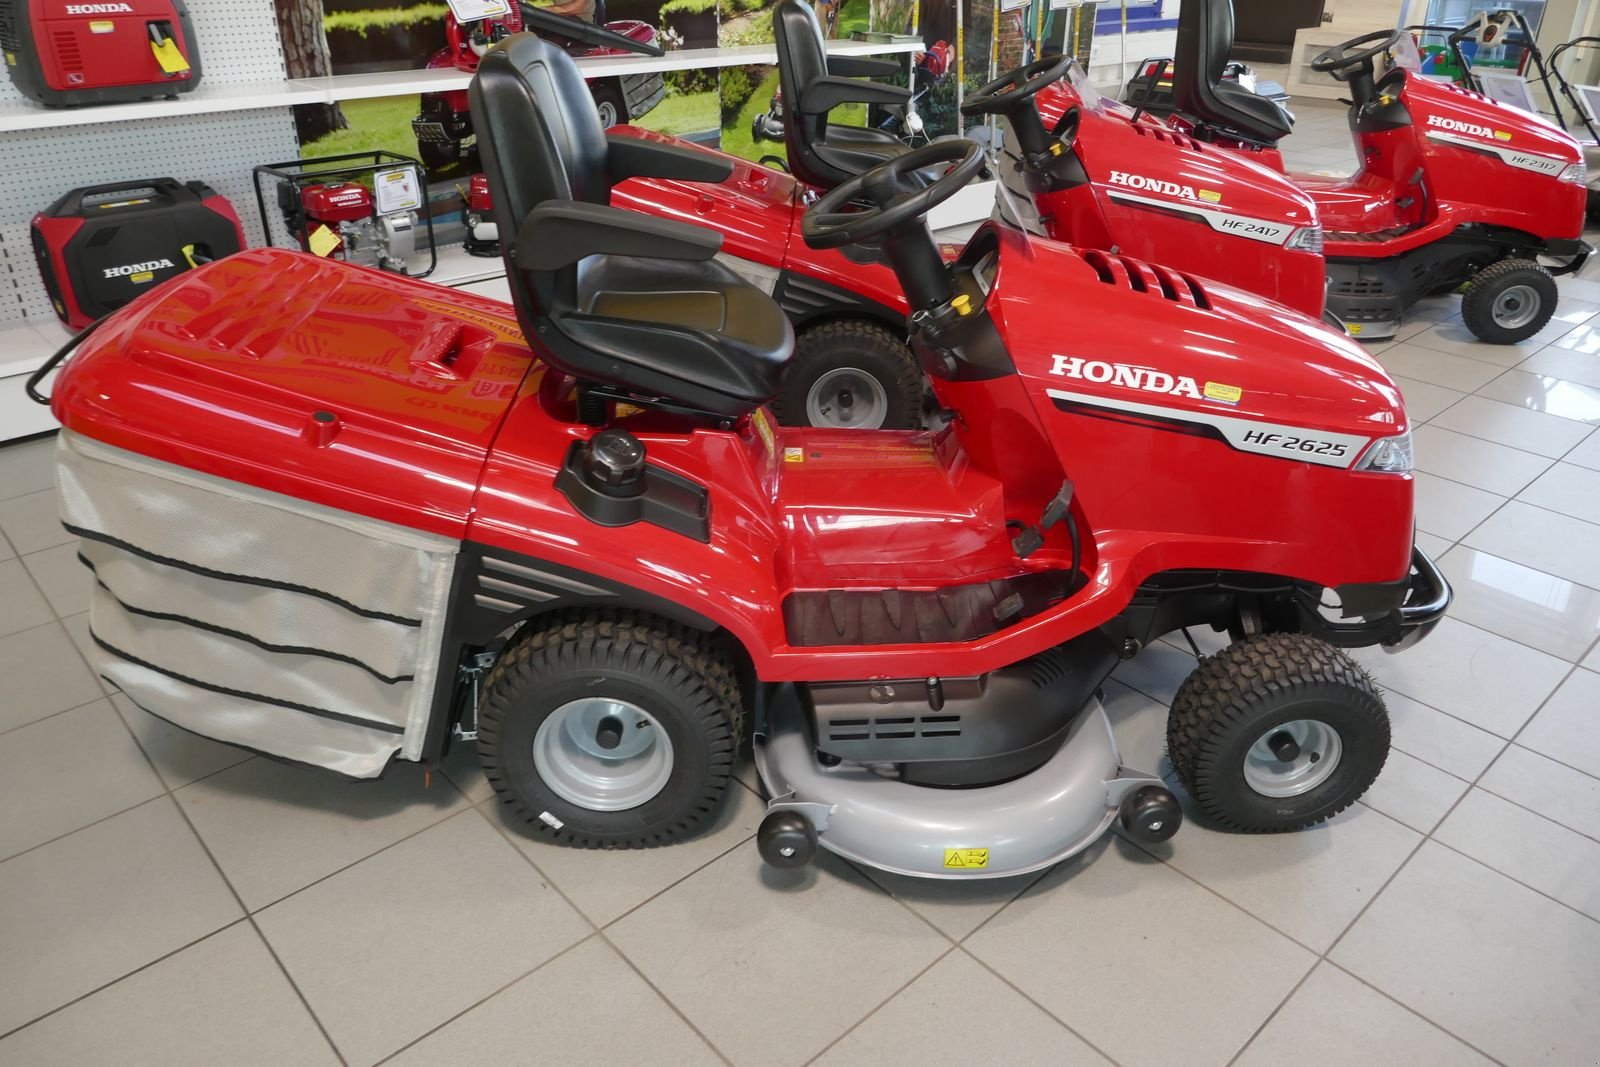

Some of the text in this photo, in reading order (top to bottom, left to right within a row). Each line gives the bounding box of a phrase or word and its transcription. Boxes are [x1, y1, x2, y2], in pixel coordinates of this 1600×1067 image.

[65, 3, 133, 15] HONDA
[1426, 115, 1495, 139] HONDA
[1512, 156, 1557, 171] HF 2317
[1108, 170, 1198, 200] HONDA
[329, 194, 361, 203] HONDA
[1222, 219, 1280, 237] HF 2417
[103, 258, 175, 279] HONDA
[1049, 354, 1203, 399] HONDA
[1243, 430, 1349, 458] HF 2625
